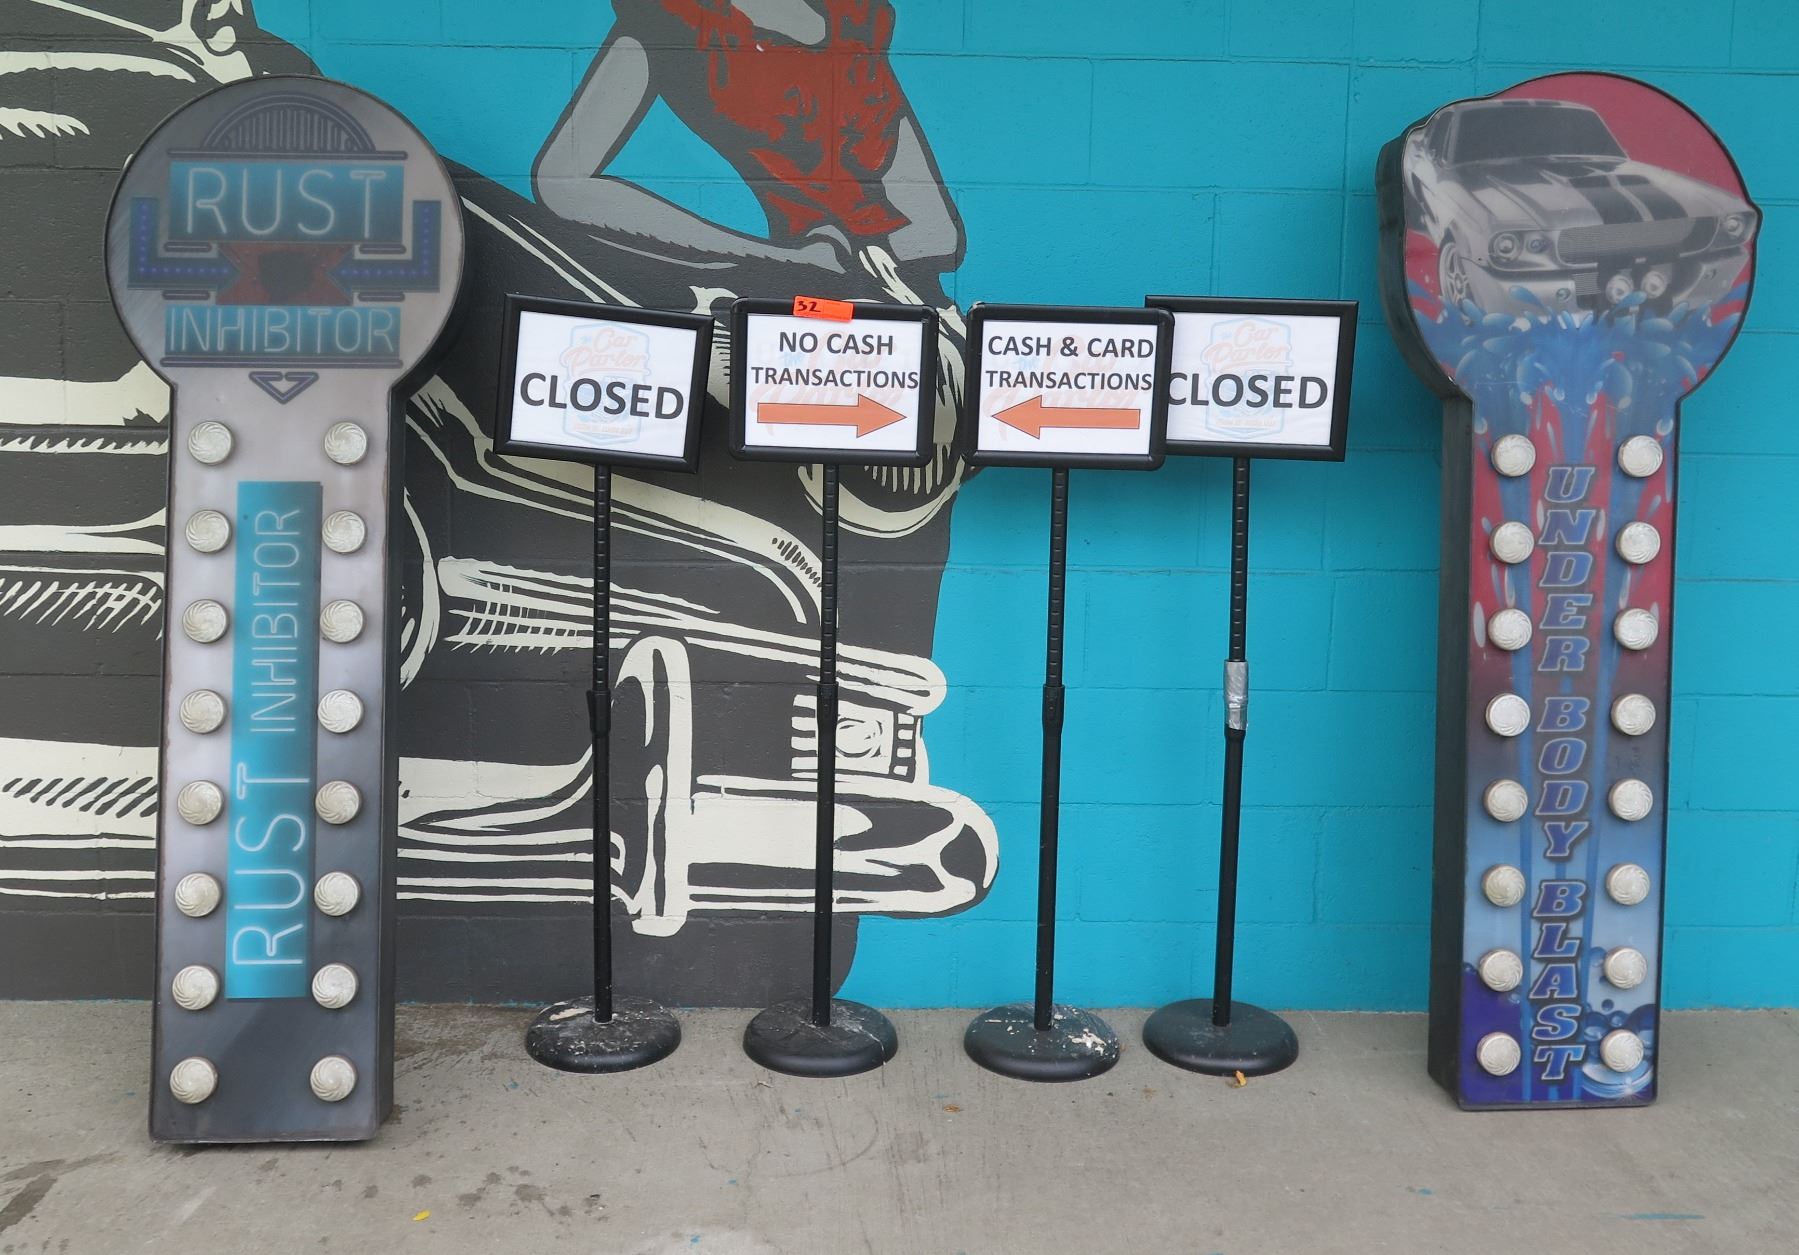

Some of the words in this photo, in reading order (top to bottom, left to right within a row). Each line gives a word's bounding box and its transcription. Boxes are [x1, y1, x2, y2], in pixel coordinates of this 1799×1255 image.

[186, 167, 386, 239] RUST
[169, 307, 394, 353] INHIBITOR
[779, 331, 818, 353] NO
[827, 333, 893, 356] CASH
[988, 335, 1051, 357] CASH
[1060, 336, 1079, 357] &
[1087, 338, 1154, 358] CARD
[520, 373, 684, 420] CLOSED
[751, 366, 919, 389] TRANSACTIONS
[985, 370, 1153, 391] TRANSACTIONS
[1168, 372, 1328, 409] CLOSED
[1537, 467, 1596, 671] UNDER
[250, 509, 301, 732] INHIBITOR
[1535, 697, 1590, 857] BODY
[232, 762, 310, 966] RUST
[1529, 881, 1586, 1080] BLAST
